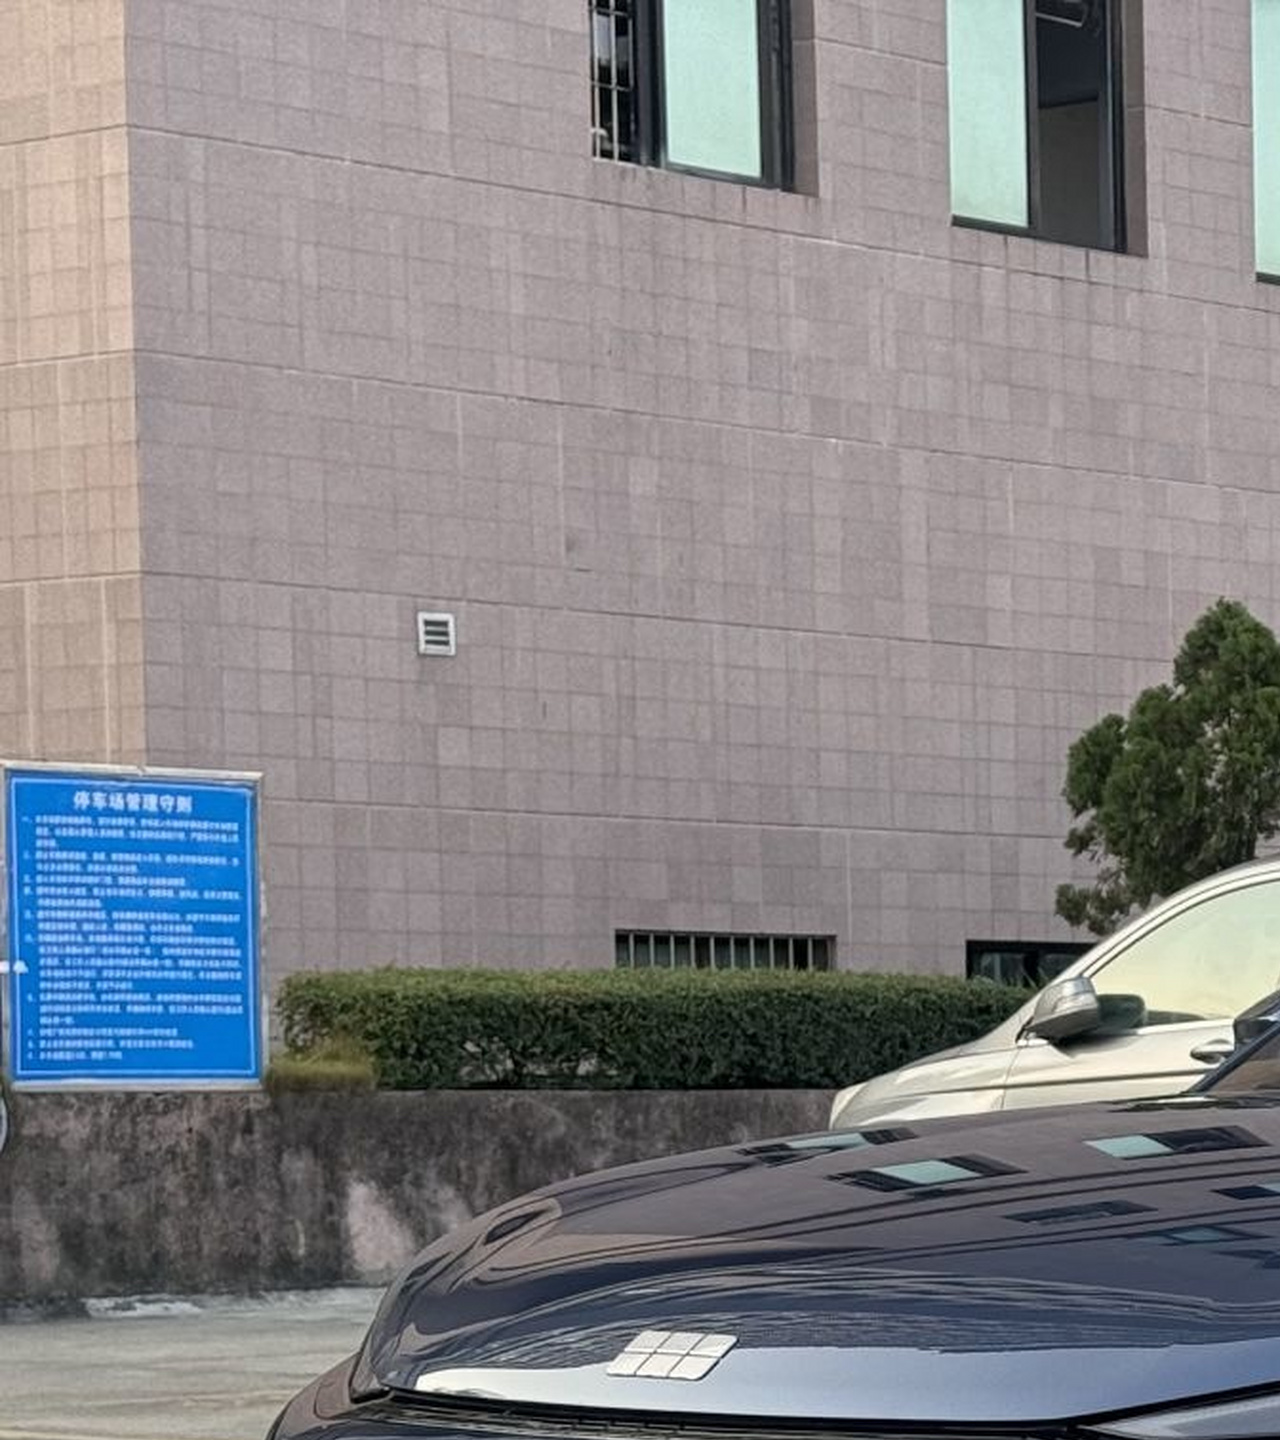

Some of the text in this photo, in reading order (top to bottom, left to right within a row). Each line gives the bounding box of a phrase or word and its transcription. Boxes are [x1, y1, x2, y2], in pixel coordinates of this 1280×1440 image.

[74, 790, 192, 813] 停车场管理守则
